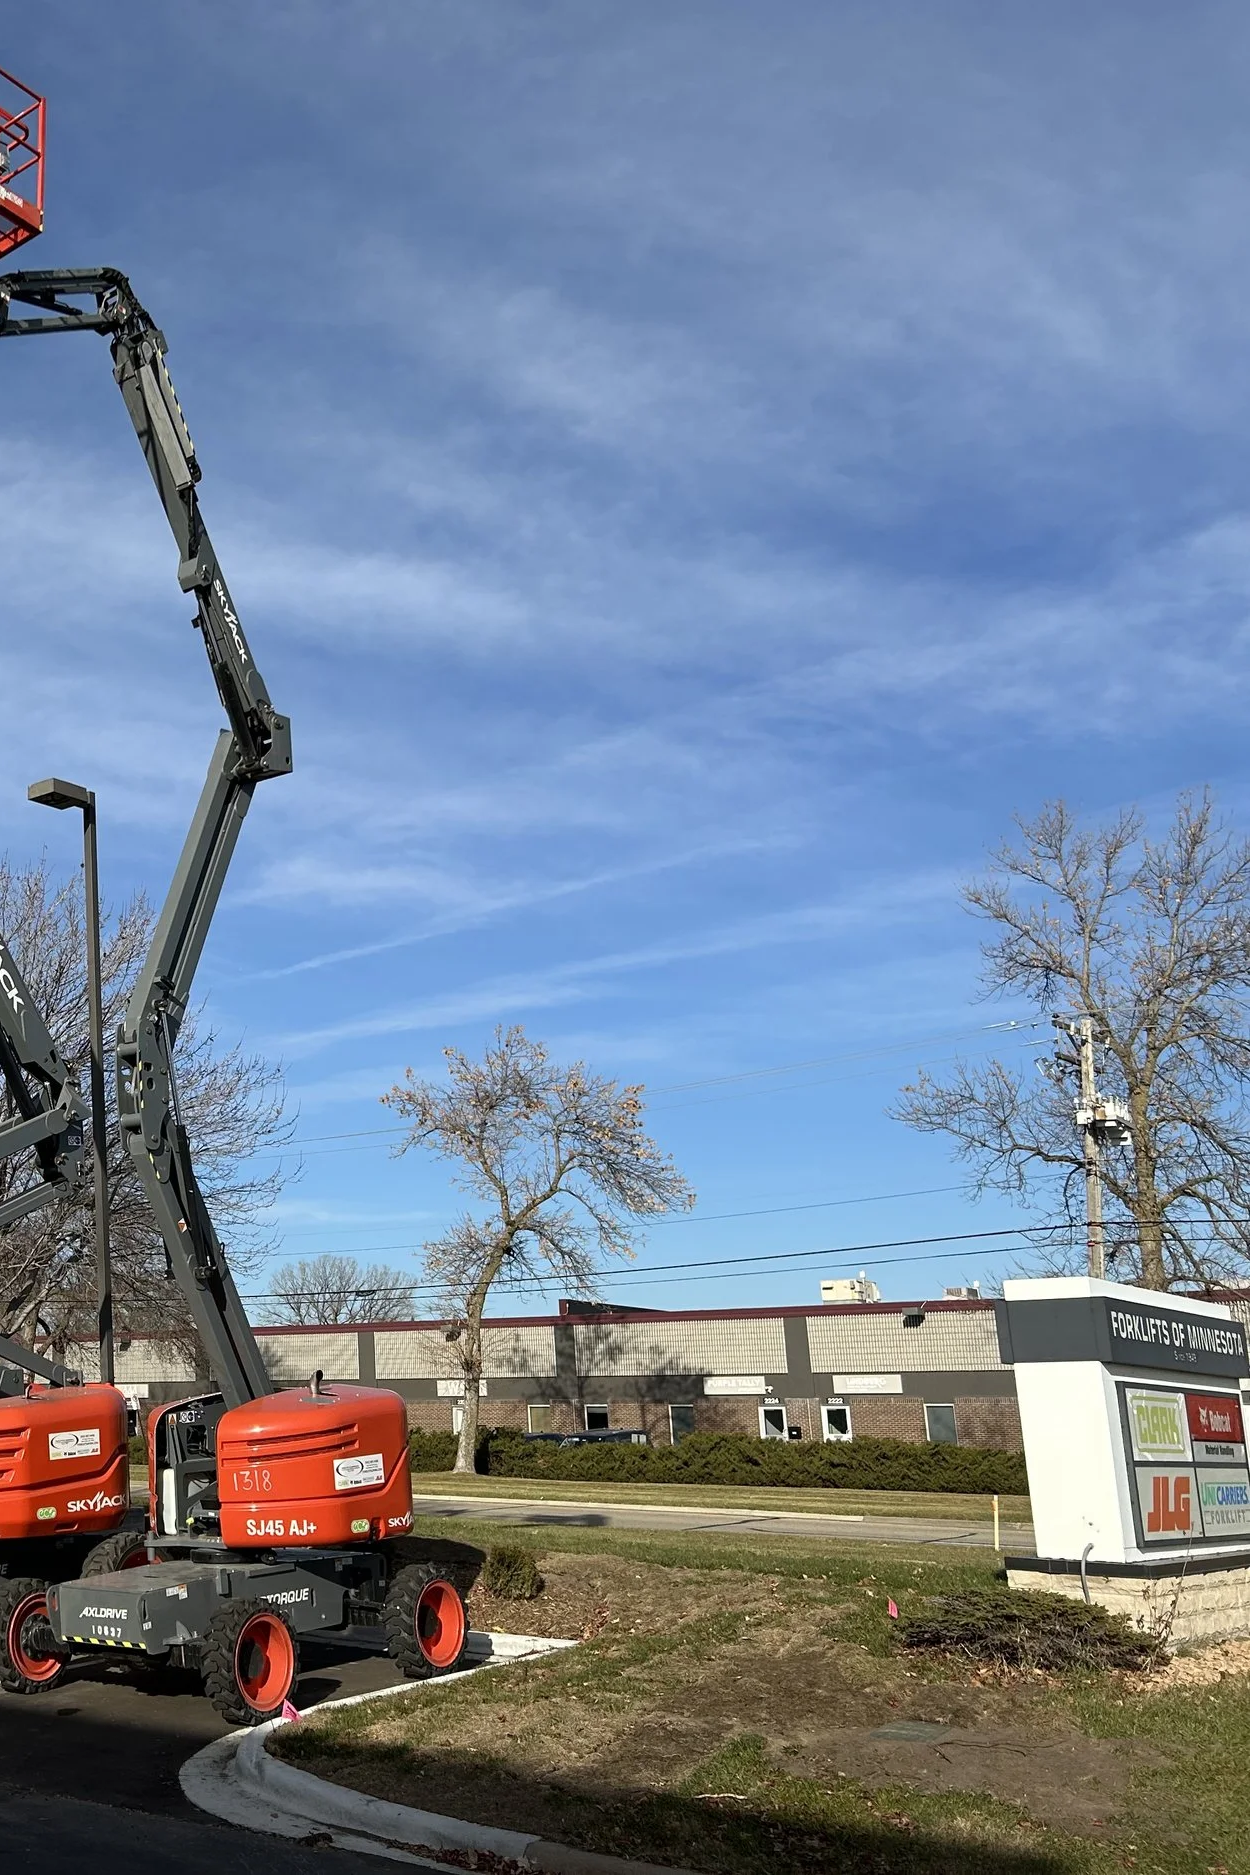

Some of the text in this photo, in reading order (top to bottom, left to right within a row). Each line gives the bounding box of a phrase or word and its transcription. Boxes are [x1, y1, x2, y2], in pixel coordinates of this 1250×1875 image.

[214, 579, 248, 664] SKYJACK
[1110, 1310, 1245, 1357] FORKLIFTS OF MINNESOTA
[1136, 1405, 1180, 1445] CLARK
[1209, 1410, 1232, 1433] Bobcat
[233, 1470, 272, 1491] 1318
[67, 1491, 126, 1513] SKYJACK
[1147, 1476, 1191, 1533] JLG
[246, 1519, 317, 1536] SJ45 AJ+
[388, 1511, 414, 1527] SKYJA
[1210, 1509, 1246, 1525] FORKLIFT
[259, 1587, 310, 1605] TORQUE
[78, 1606, 128, 1620] AXLDRIVE
